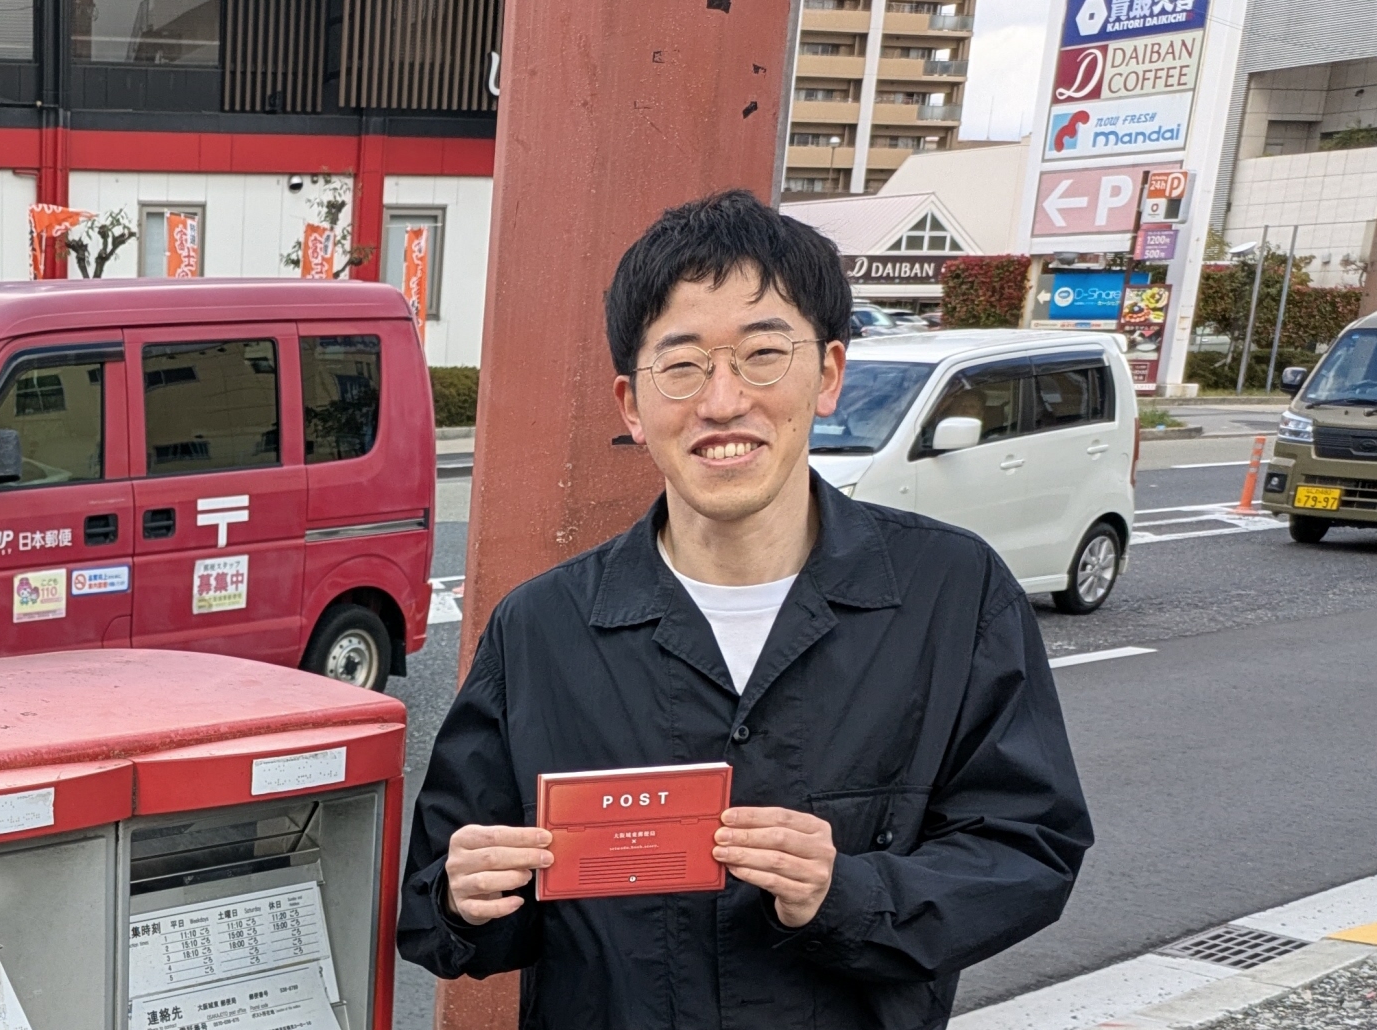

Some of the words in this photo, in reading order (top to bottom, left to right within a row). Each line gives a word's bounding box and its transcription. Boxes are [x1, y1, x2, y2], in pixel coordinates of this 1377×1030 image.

[1106, 19, 1143, 33] KAITORI
[1145, 12, 1187, 27] DAIKICHI
[1111, 38, 1196, 69] DAIBAN
[1108, 65, 1191, 94] COFFEE
[1123, 112, 1157, 126] FRESH
[1092, 123, 1181, 148] mandai
[1149, 180, 1166, 191] 24h
[1094, 174, 1133, 226] P
[871, 262, 936, 278] DAIBAN
[1303, 494, 1338, 510] 79-97
[19, 528, 73, 551] 日本郵便
[40, 578, 59, 586] こども
[197, 569, 245, 596] 募集中
[603, 791, 669, 809] POST
[268, 900, 282, 911] 休日
[218, 909, 238, 920] 土曜日
[272, 912, 287, 921] 11:20
[289, 909, 300, 918] ごろ
[170, 919, 185, 929] 平日
[227, 921, 243, 930] 11:10
[246, 918, 257, 926] ごろ
[273, 921, 288, 930] 15:00
[290, 918, 301, 927] ごろ
[130, 922, 161, 939] 集時刻
[180, 930, 197, 939] 11:10
[199, 927, 210, 935] ごろ
[228, 930, 244, 939] 15:00
[247, 927, 258, 936] ごろ
[291, 928, 302, 936] ごろ
[181, 940, 198, 949] 15:10
[200, 937, 211, 945] ごろ
[229, 940, 245, 949] 18:00
[248, 937, 259, 946] ごろ
[292, 937, 303, 946] ごろ
[182, 949, 199, 959] 18:10
[201, 947, 212, 955] ごろ
[249, 946, 260, 955] ごろ
[293, 946, 304, 955] ごろ
[203, 956, 214, 964] ごろ
[250, 956, 261, 965] ごろ
[204, 966, 215, 974] ごろ
[220, 997, 237, 1007] 郵便局
[147, 1005, 183, 1026] 連絡先
